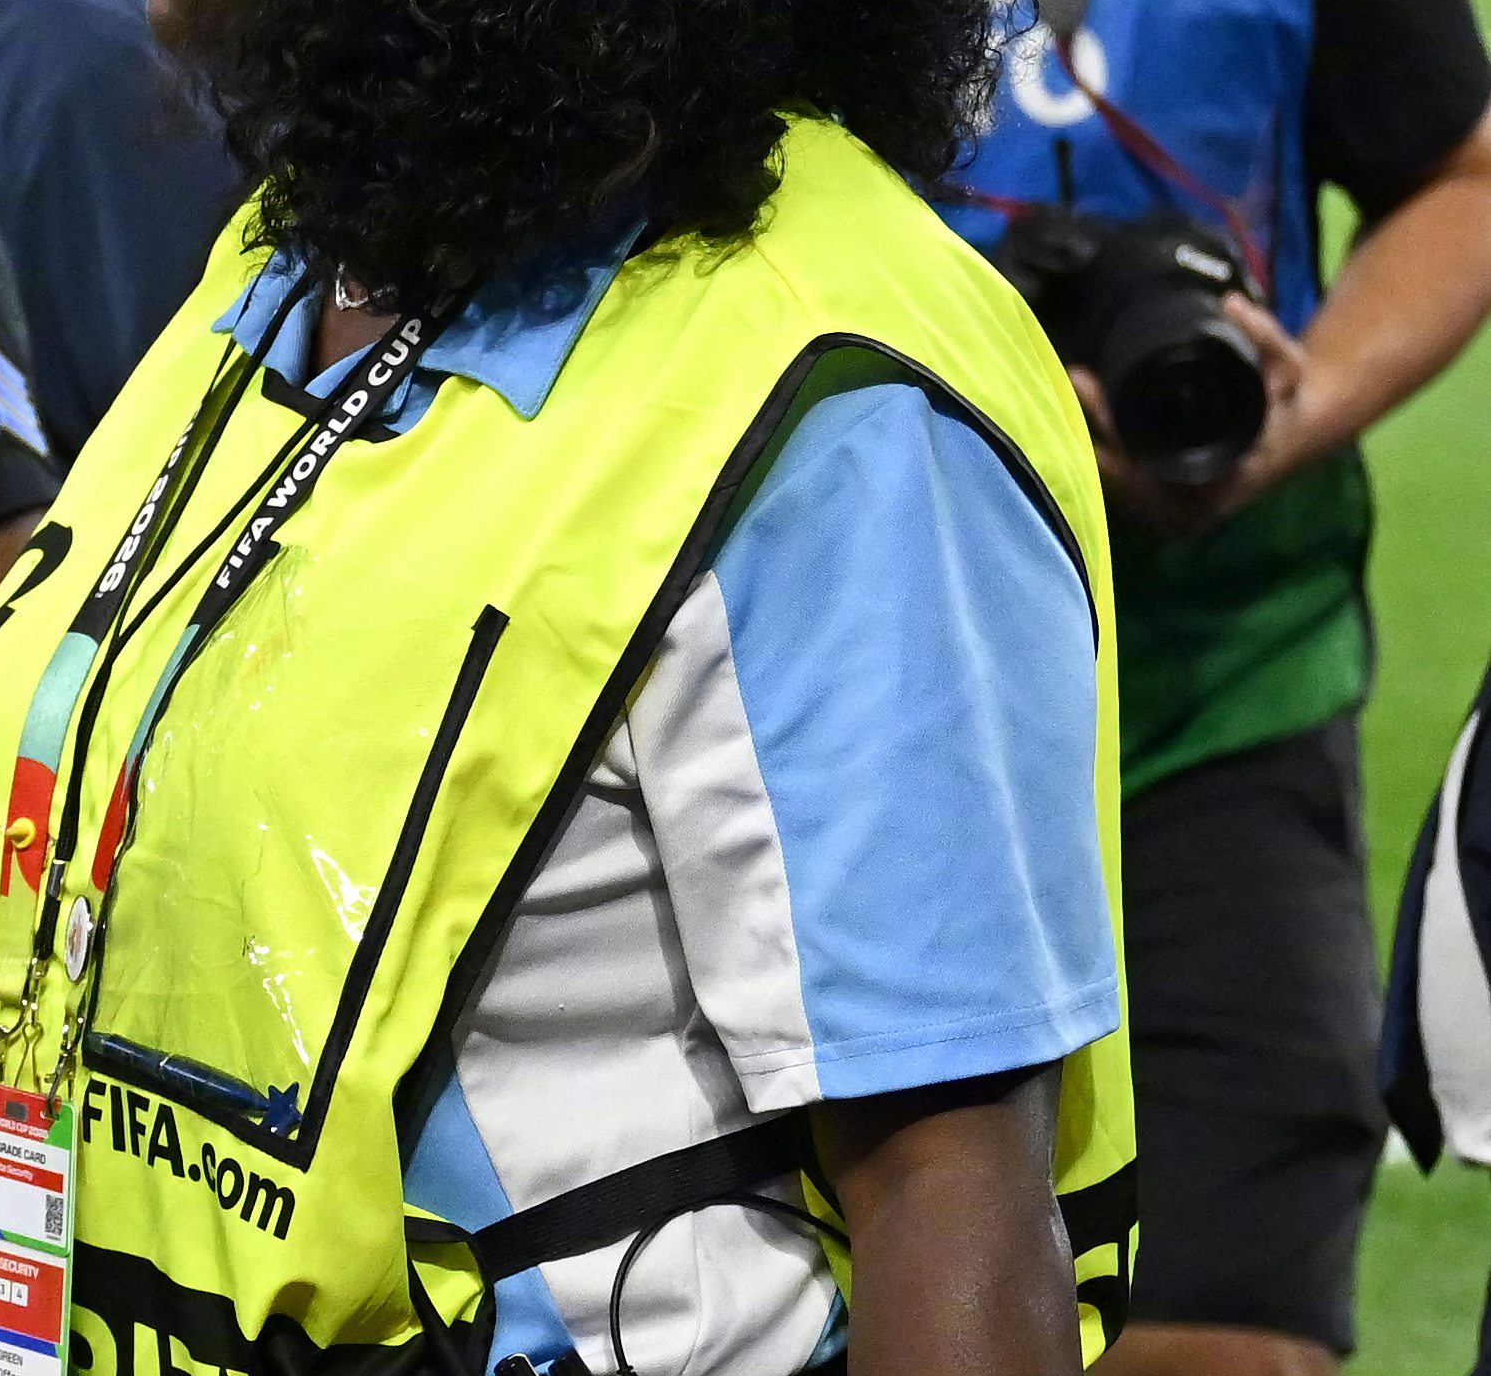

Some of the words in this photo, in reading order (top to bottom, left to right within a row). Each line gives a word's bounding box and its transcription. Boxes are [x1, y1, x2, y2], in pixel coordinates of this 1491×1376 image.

[216, 515, 274, 589] FIFA
[266, 389, 369, 509] WORLD
[367, 318, 423, 387] CUP
[23, 1149, 46, 1165] CARD
[82, 1076, 296, 1241] FIFA.com
